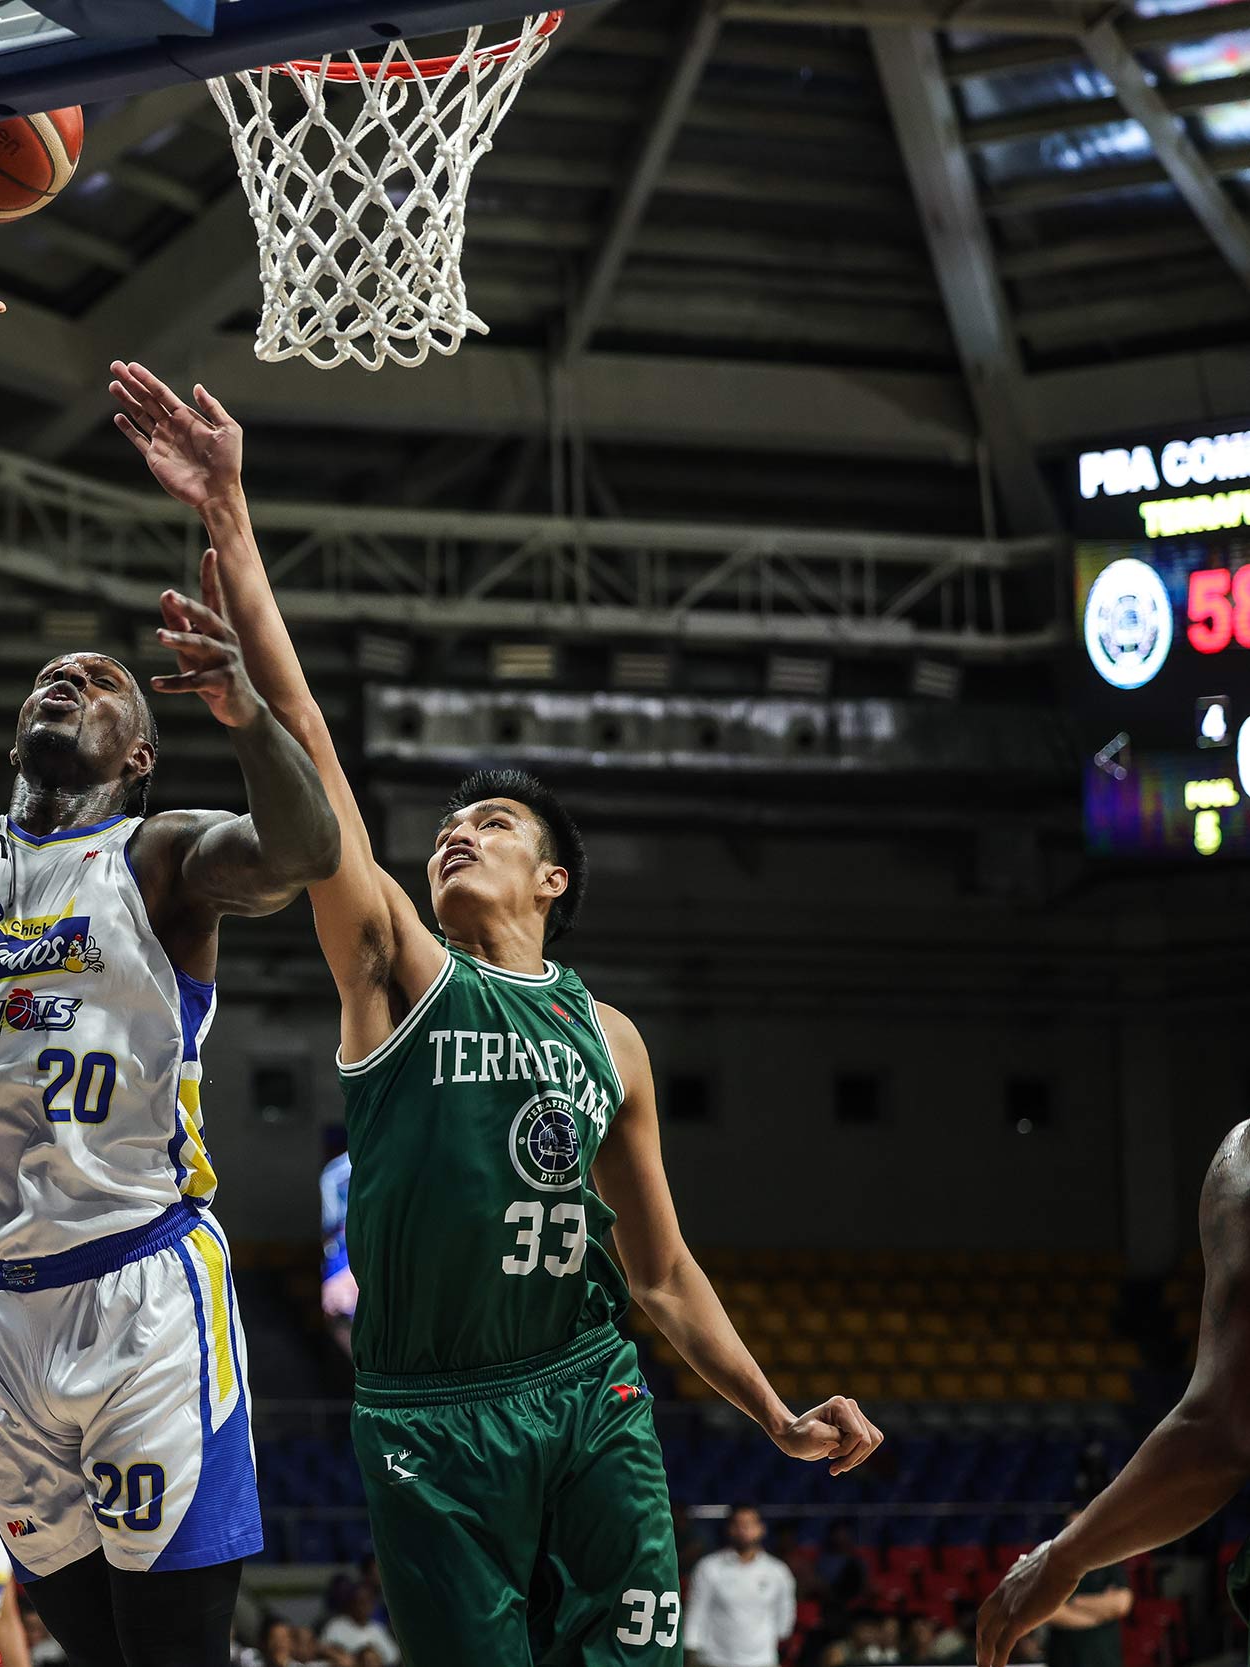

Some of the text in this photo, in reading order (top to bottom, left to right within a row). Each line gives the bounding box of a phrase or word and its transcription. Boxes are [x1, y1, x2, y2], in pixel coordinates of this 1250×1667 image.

[1161, 432, 1250, 487] COM
[37, 1048, 117, 1124] 20
[540, 1172, 565, 1183] DYIP
[502, 1200, 587, 1278] 33
[6, 1516, 38, 1538] PBA
[91, 1462, 165, 1532] 20
[616, 1588, 681, 1648] 33
